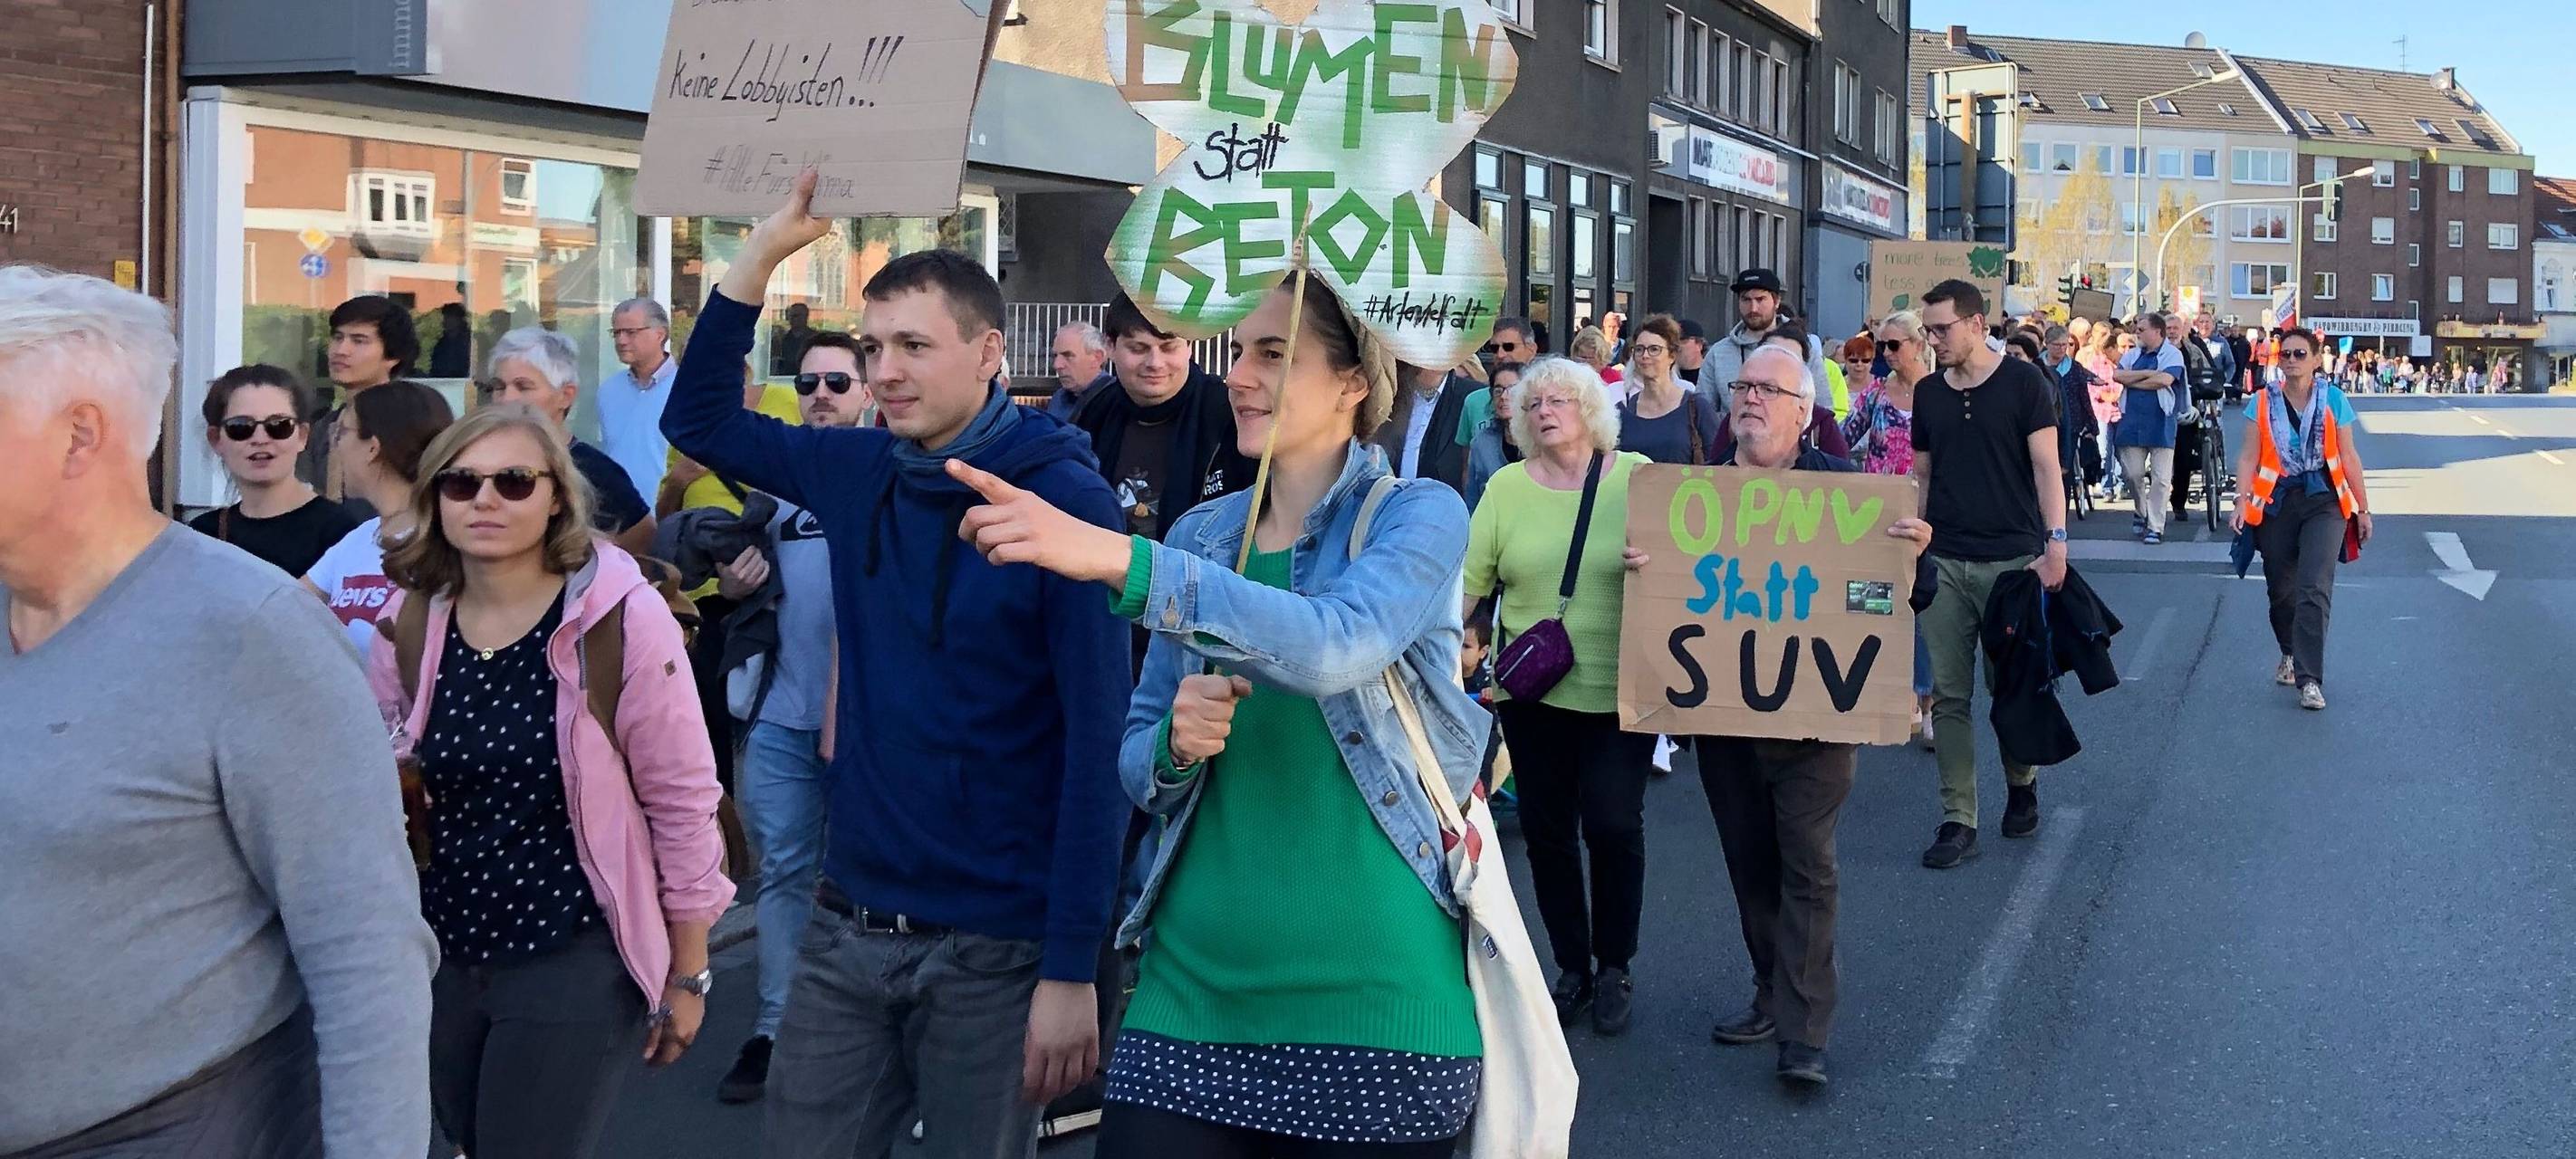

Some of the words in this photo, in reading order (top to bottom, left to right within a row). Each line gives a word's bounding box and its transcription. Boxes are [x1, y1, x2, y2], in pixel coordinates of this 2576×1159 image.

[668, 49, 718, 101] Keine
[1120, 0, 1495, 148] BLUMEN
[1139, 171, 1449, 319] BETON
[1884, 253, 1924, 266] more
[1669, 467, 1884, 556] ÖPNV
[1666, 624, 1882, 714] SUV
